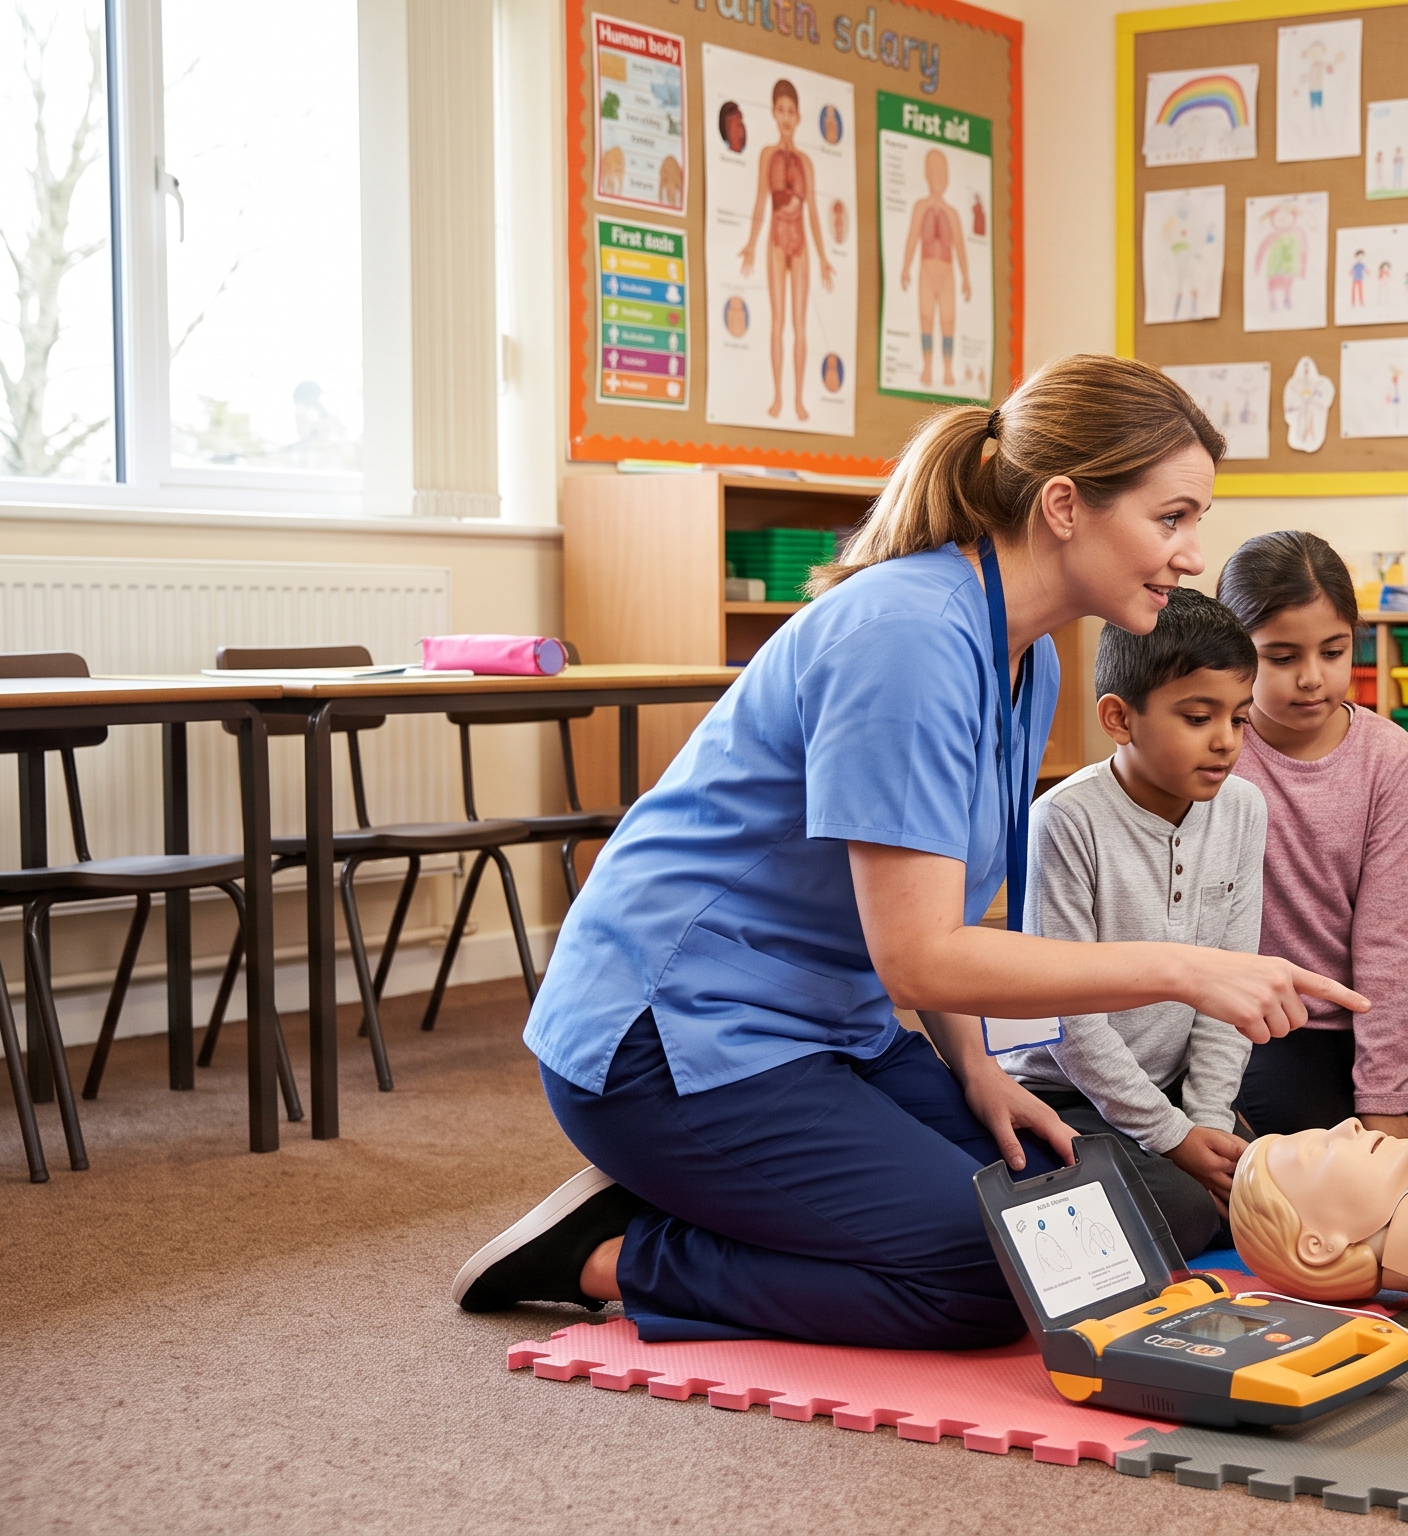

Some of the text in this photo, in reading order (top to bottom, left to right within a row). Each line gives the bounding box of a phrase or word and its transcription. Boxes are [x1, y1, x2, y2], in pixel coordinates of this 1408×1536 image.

[600, 23, 679, 63] Human body
[903, 103, 970, 144] First aid
[611, 225, 642, 248] First
